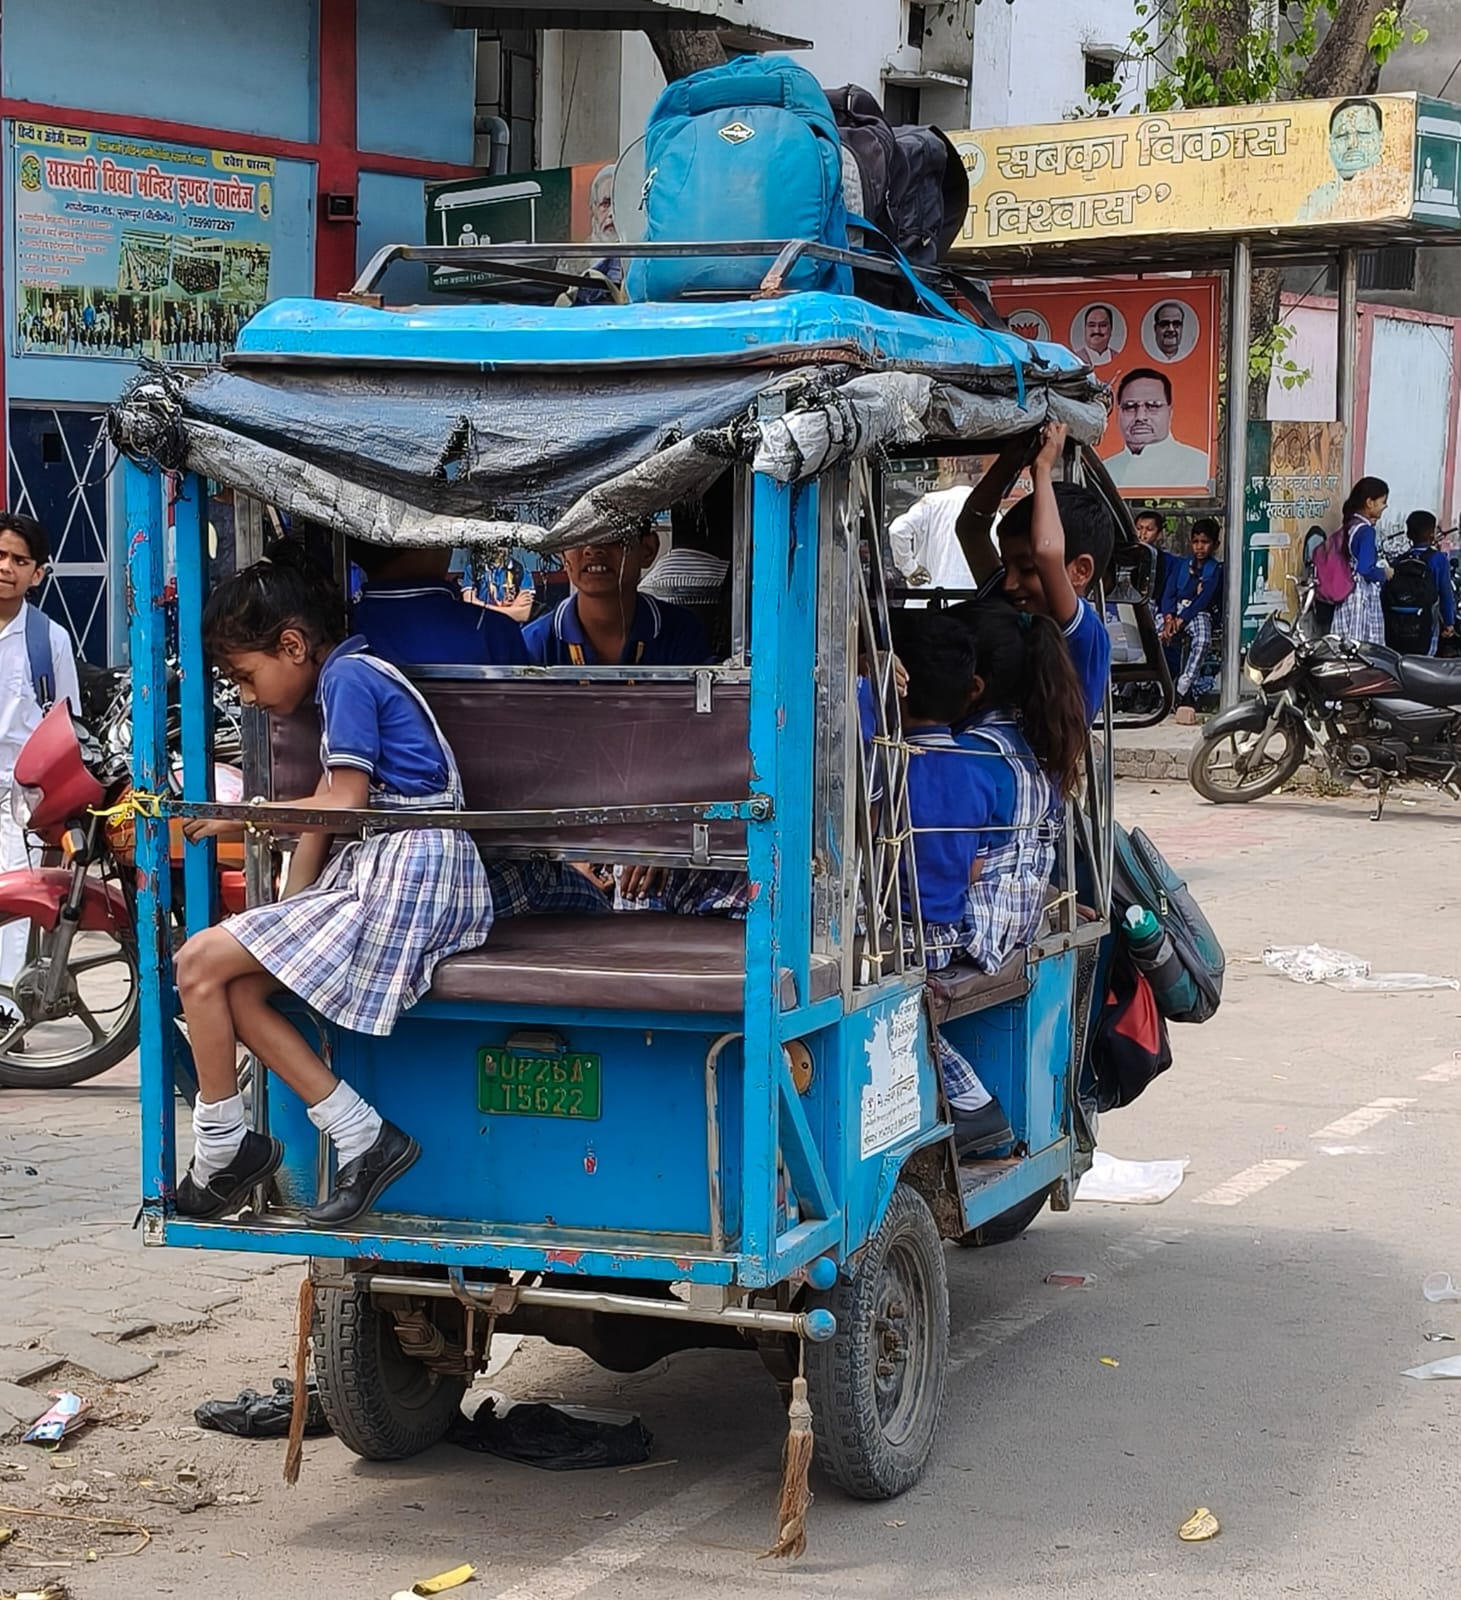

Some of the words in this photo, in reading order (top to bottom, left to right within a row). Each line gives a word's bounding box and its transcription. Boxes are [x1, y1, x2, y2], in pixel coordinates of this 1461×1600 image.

[996, 133, 1129, 180] सबका
[1136, 117, 1292, 167] विकास
[46, 158, 97, 190] सरस्वती
[102, 160, 133, 194] विद्या
[137, 166, 173, 199] मन्दिर
[178, 177, 208, 207] इण्टर
[213, 175, 254, 209] कालेज
[501, 1083, 584, 1114] T5622
